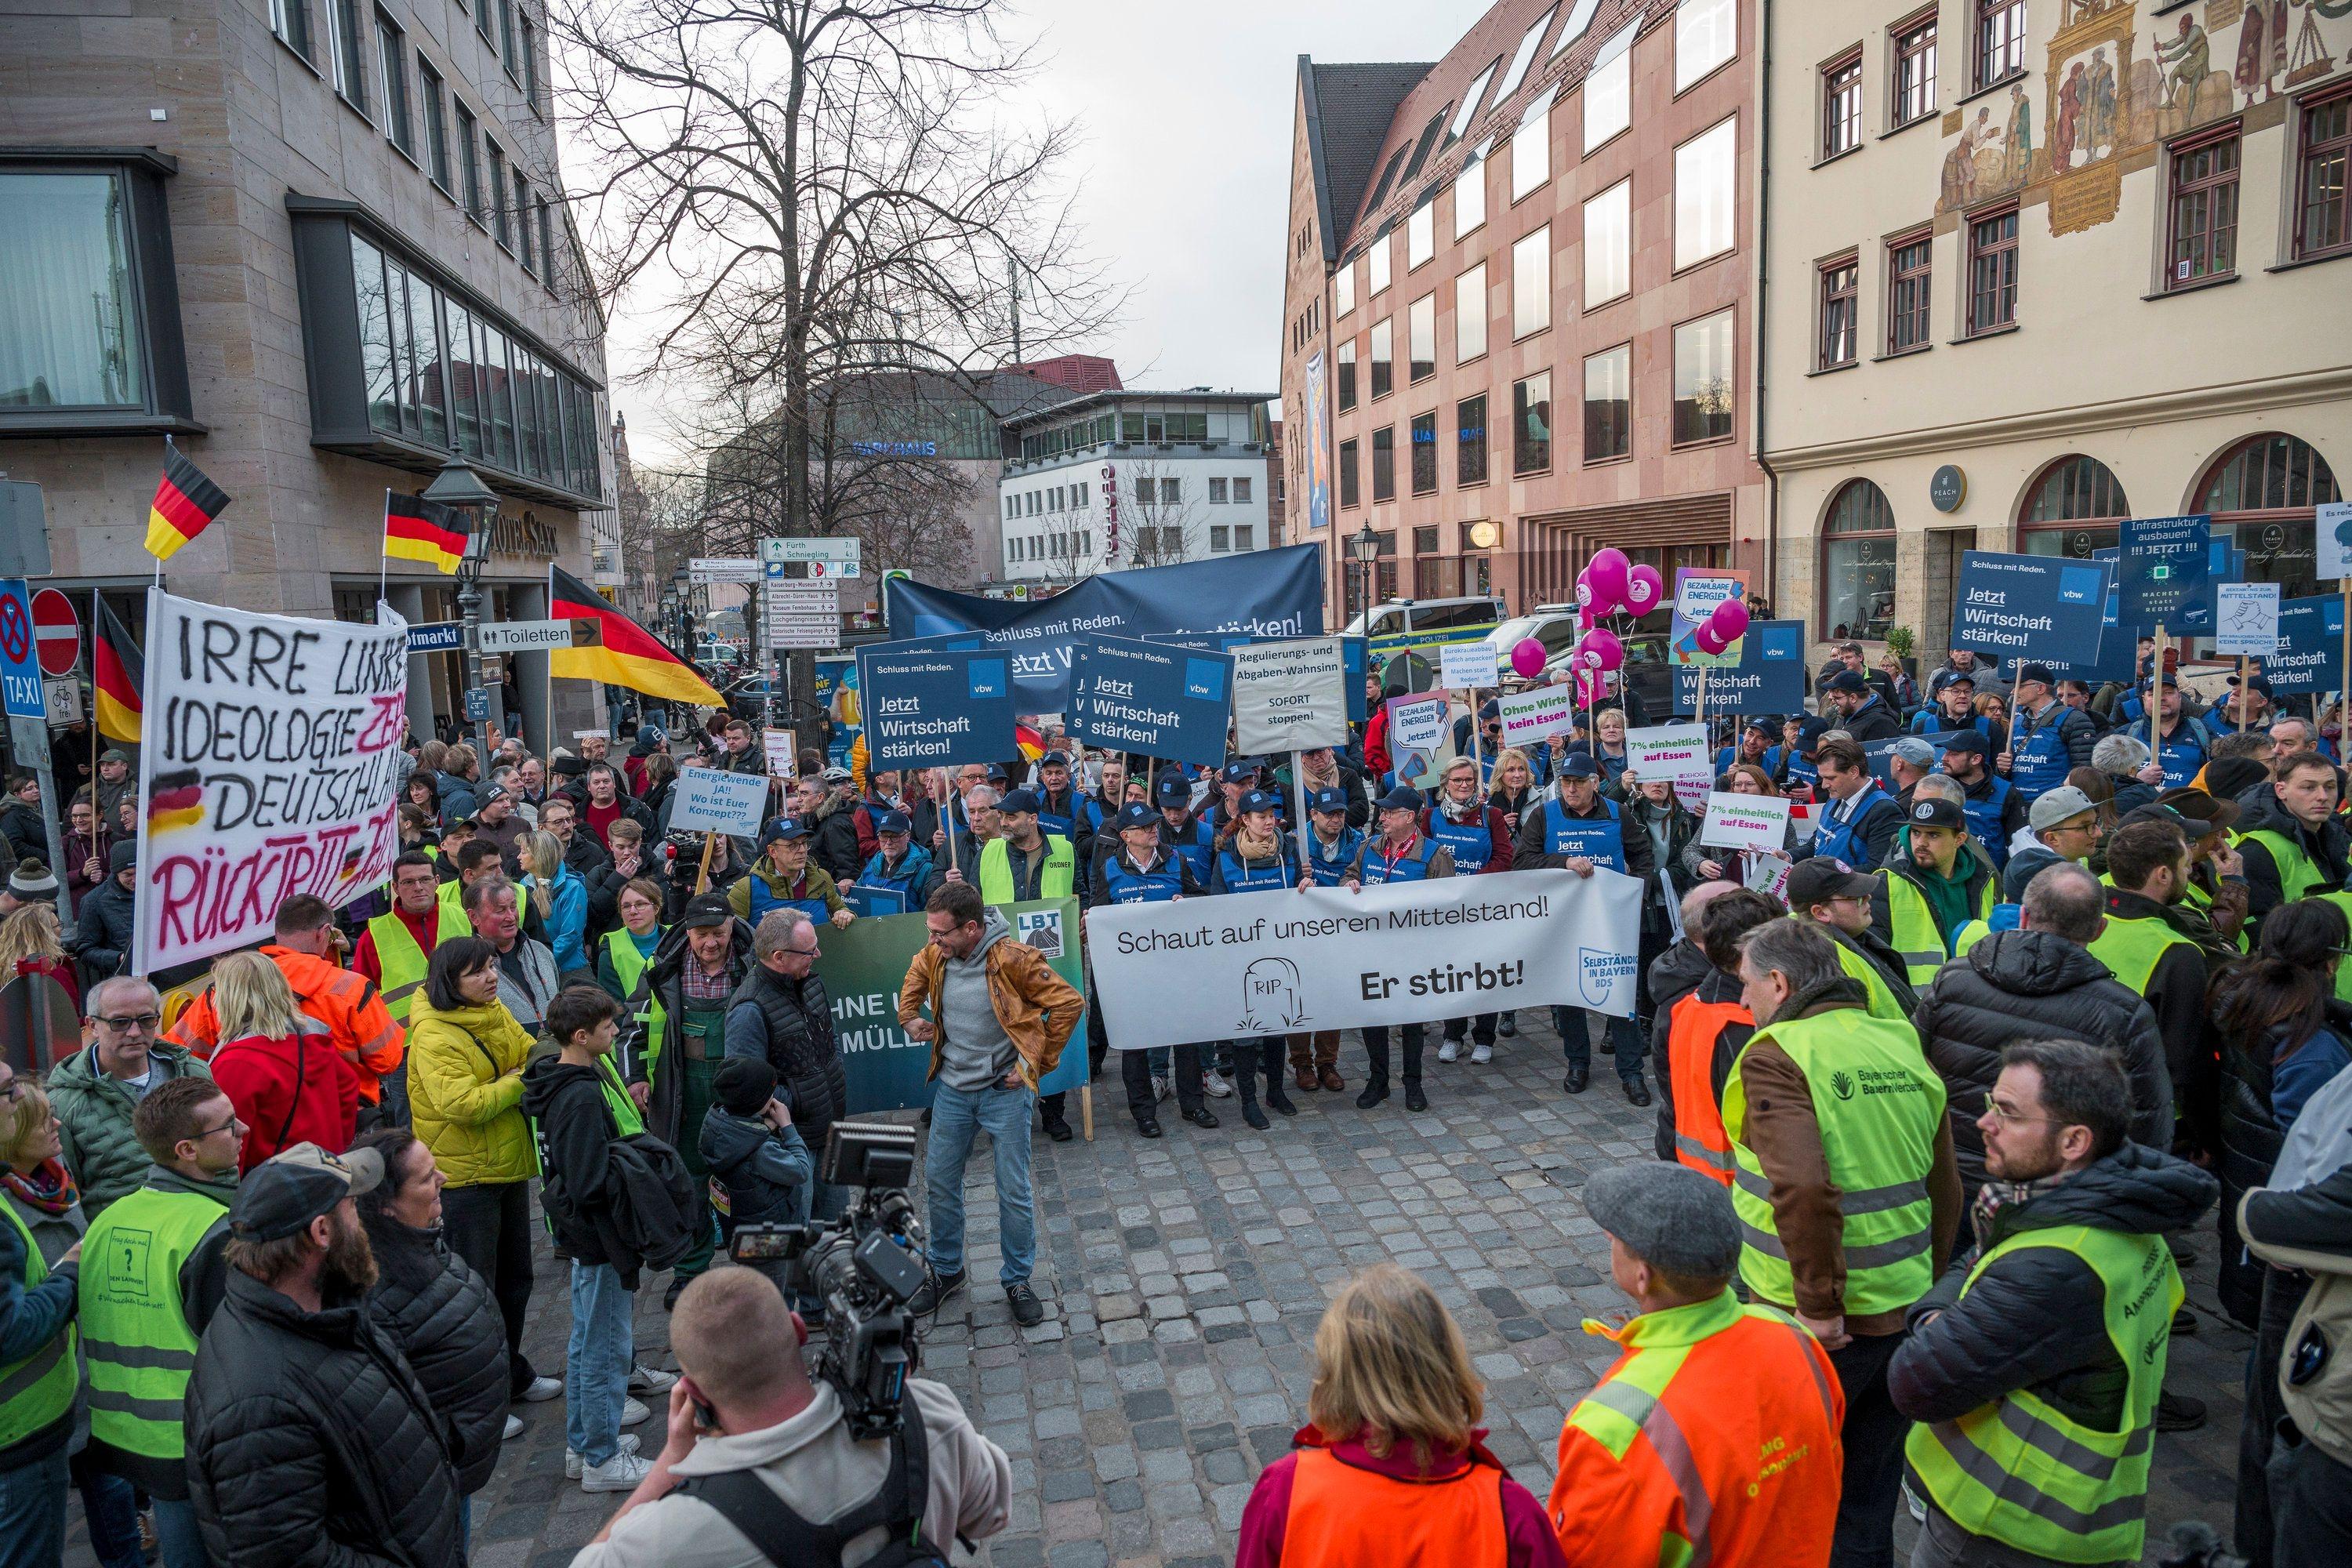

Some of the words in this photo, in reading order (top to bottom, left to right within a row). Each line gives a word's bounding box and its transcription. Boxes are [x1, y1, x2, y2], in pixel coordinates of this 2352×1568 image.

[2131, 517, 2199, 531] Infrastruktur
[2138, 528, 2191, 541] ausbauen!
[786, 550, 829, 560] Schniegling
[2131, 546, 2143, 555] !!!
[2146, 543, 2182, 554] JETZT
[2186, 543, 2198, 552] !!!
[1972, 561, 2002, 570] Schluss
[2018, 564, 2046, 574] Reden.
[1687, 582, 1730, 590] BEZAHLBARE
[1966, 587, 2005, 604] Jetzt
[2063, 590, 2084, 600] vbw
[1965, 608, 2052, 631] Wirtschaft
[500, 627, 570, 644] Toiletten
[985, 626, 1042, 642] Schluss
[1045, 621, 1071, 636] mit
[1072, 614, 1126, 633] Reden.
[1420, 635, 1449, 644] POLIZEI
[1962, 629, 2028, 647] stärken!
[179, 615, 321, 695] IRRE
[1097, 646, 1129, 659] Schluss
[1130, 650, 1144, 660] mit
[1145, 652, 1172, 664] Reden.
[1239, 648, 1310, 664] Regulierungs-
[1312, 644, 1334, 657] und
[1465, 655, 1494, 663] anpacken!
[2266, 652, 2326, 669] Wirtschaft
[877, 665, 909, 674] Schluss
[911, 663, 924, 673] mit
[926, 663, 953, 672] Reden.
[1012, 651, 1056, 673] etzt
[1236, 662, 1338, 681] Abgaben-Wahnsinn
[2267, 670, 2313, 684] stärken!
[1094, 676, 1134, 696] Jetzt
[1682, 674, 1761, 688] Wrtschaft
[5, 676, 40, 705] TAXI
[1189, 684, 1209, 695] vbw
[879, 696, 920, 713] Jetzt
[1269, 695, 1311, 707] SOFORT
[1502, 703, 1535, 717] Ohne
[1536, 695, 1567, 710] Wirte
[59, 710, 71, 719] frei
[1093, 699, 1180, 728] Wirtschaft
[1268, 711, 1314, 725] stoppen!
[1399, 705, 1436, 717] BEZAHLBARE
[880, 717, 971, 738] Wirtschaft
[1507, 718, 1534, 731] kein
[1536, 710, 1567, 725] Essen
[163, 696, 365, 768] IDEOLOGIE
[1091, 722, 1158, 745] stärken!
[1406, 729, 1436, 742] Jetzt!!!
[882, 739, 950, 759] stärken!
[1631, 742, 1647, 750] 7%
[1649, 738, 1704, 749] einheitlich
[1643, 753, 1661, 762] auf
[1662, 751, 1692, 760] Essen
[688, 768, 761, 788] Energiewende
[713, 785, 731, 795] JA!!
[691, 793, 708, 804] Wo
[710, 796, 724, 806] ist
[725, 798, 750, 809] Euer
[688, 805, 746, 821] Konzept???
[1711, 806, 1726, 815] 7%
[1728, 808, 1784, 821] einheitlich
[1719, 818, 1737, 828] auf
[1738, 821, 1768, 831] Essen
[1436, 833, 1455, 841] Schluss
[1558, 840, 1584, 851] Jetzt
[1365, 873, 1384, 884] Jetzt
[1765, 869, 1777, 884] auf
[1118, 884, 1139, 894] Schluss
[1772, 878, 1785, 896] sind
[840, 896, 861, 905] Reden.
[1018, 913, 1058, 931] LBT
[1117, 925, 1214, 954] Schaut
[1221, 918, 1265, 944] auf
[1274, 915, 1380, 939] unseren
[1388, 895, 1550, 931] Mittelstand!
[1589, 969, 1598, 978] IN
[1599, 965, 1636, 977] BAYERN
[1254, 978, 1282, 996] RIP
[1360, 971, 1399, 1000] Er
[1410, 960, 1524, 996] stirbt!
[1595, 978, 1613, 989] BDS
